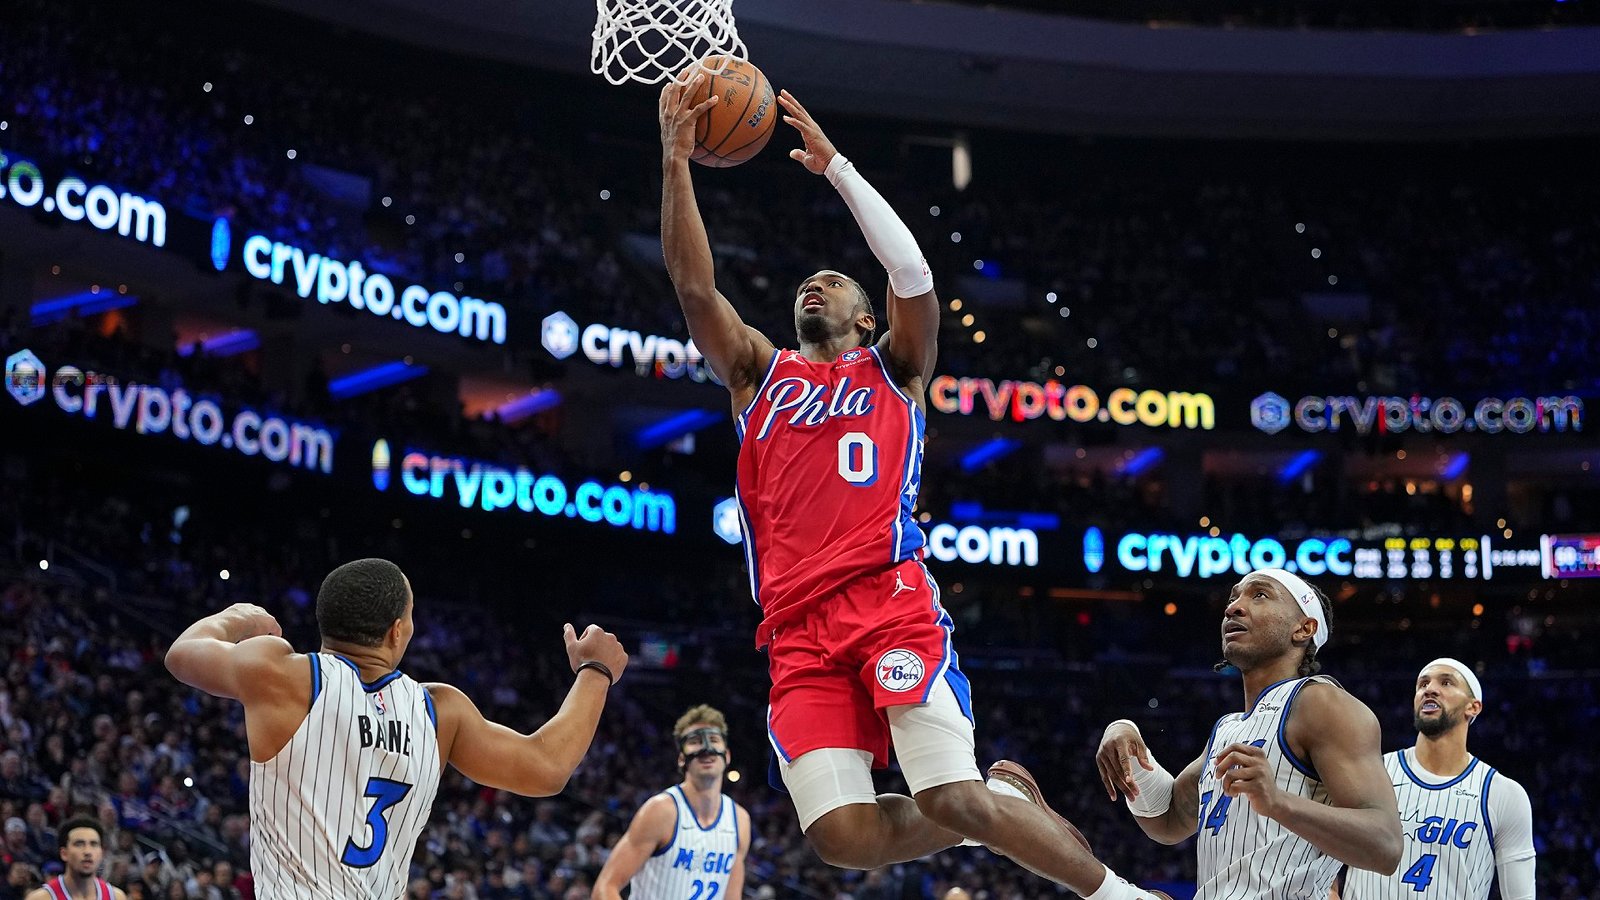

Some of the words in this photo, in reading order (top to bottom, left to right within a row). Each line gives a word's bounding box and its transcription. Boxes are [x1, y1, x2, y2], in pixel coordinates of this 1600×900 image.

[243, 234, 506, 344] crypto.com
[52, 366, 334, 474] crypto.com
[929, 375, 1215, 430] crypto.com
[1294, 392, 1584, 434] crypto.com
[838, 432, 878, 487] 0
[401, 452, 676, 534] crypto.com
[881, 665, 919, 681] 76ers
[1258, 702, 1281, 714] Disney
[357, 714, 412, 757] BANE
[1455, 788, 1479, 799] Disney
[341, 776, 413, 868] 3
[688, 879, 719, 900] 22
[1401, 853, 1438, 892] 4
